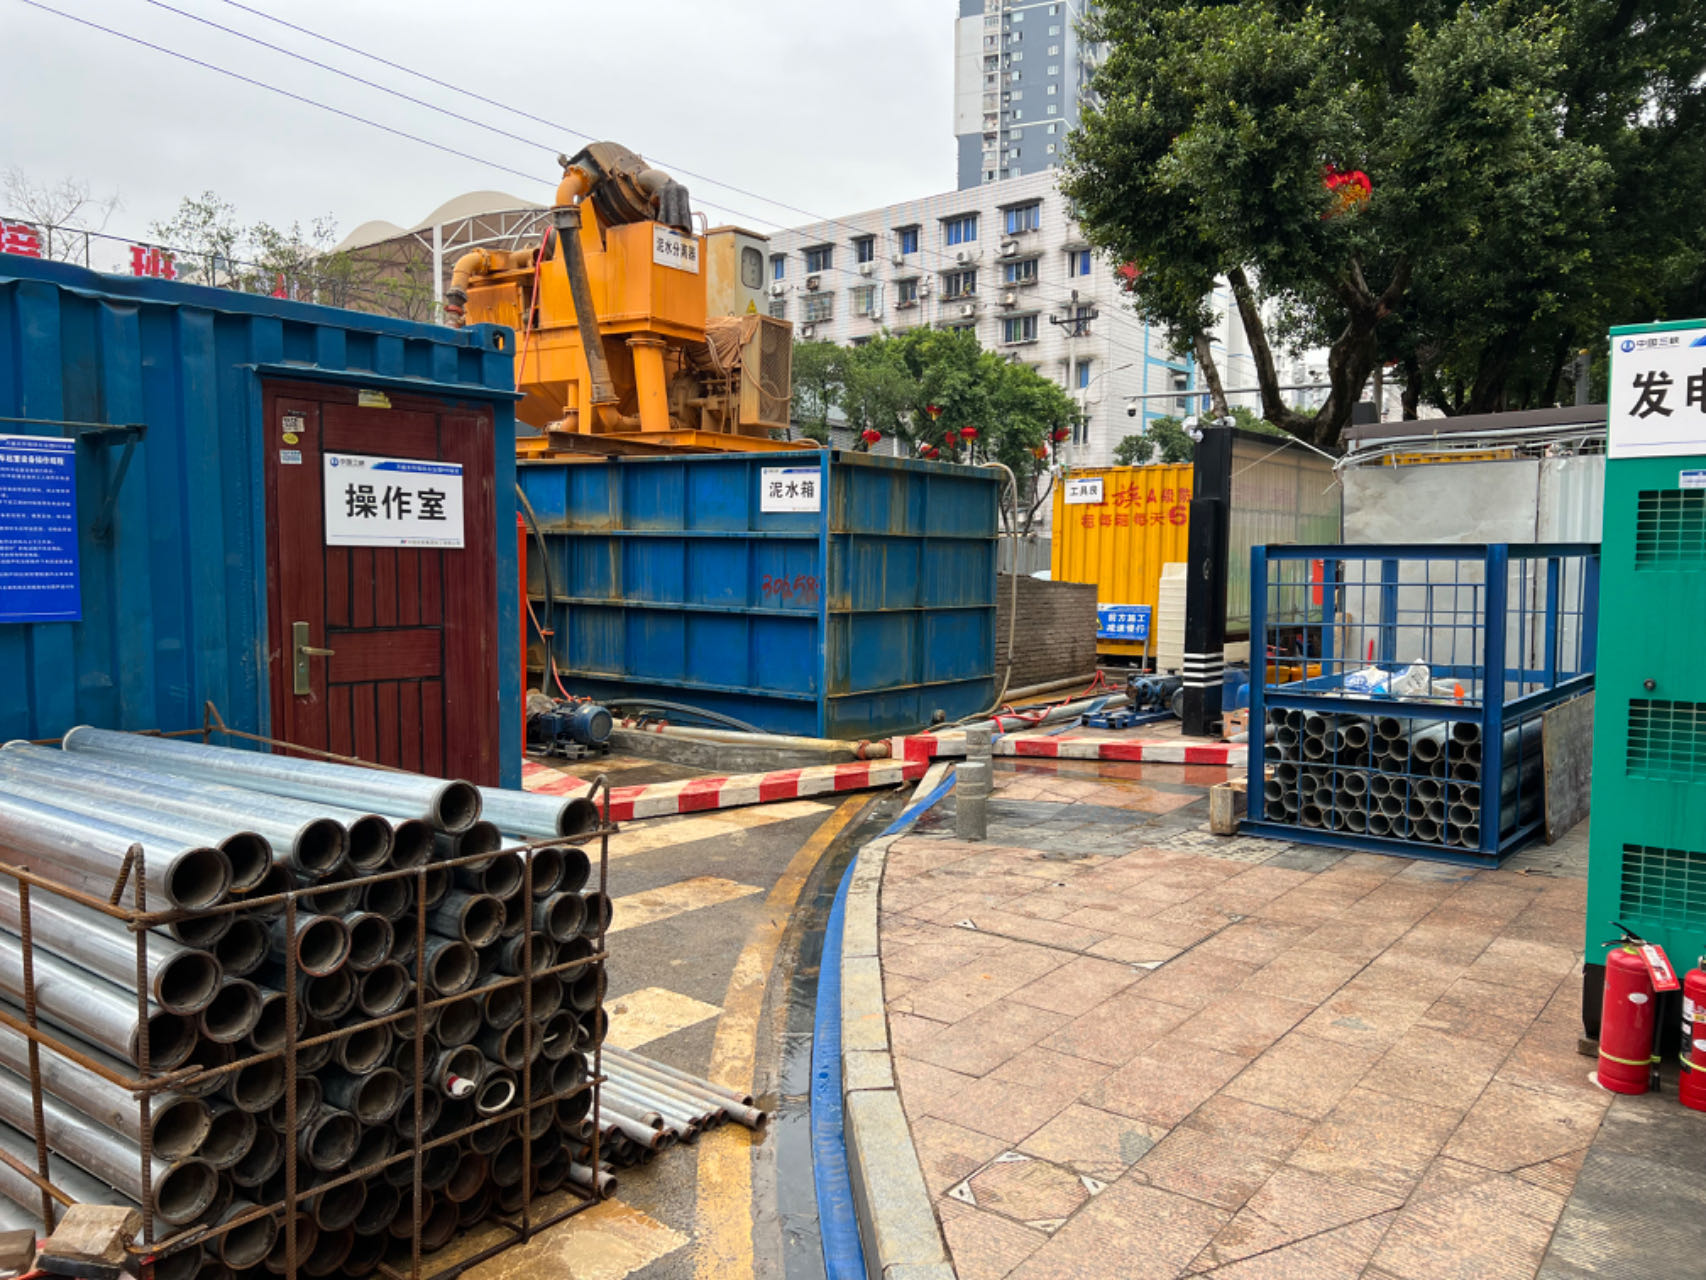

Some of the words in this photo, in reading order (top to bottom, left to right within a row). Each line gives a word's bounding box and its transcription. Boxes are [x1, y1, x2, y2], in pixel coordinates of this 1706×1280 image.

[657, 237, 696, 261] 泥水分离器
[1636, 336, 1679, 348] 中国三峡
[769, 481, 815, 499] 泥水箱
[345, 483, 447, 521] 操作室
